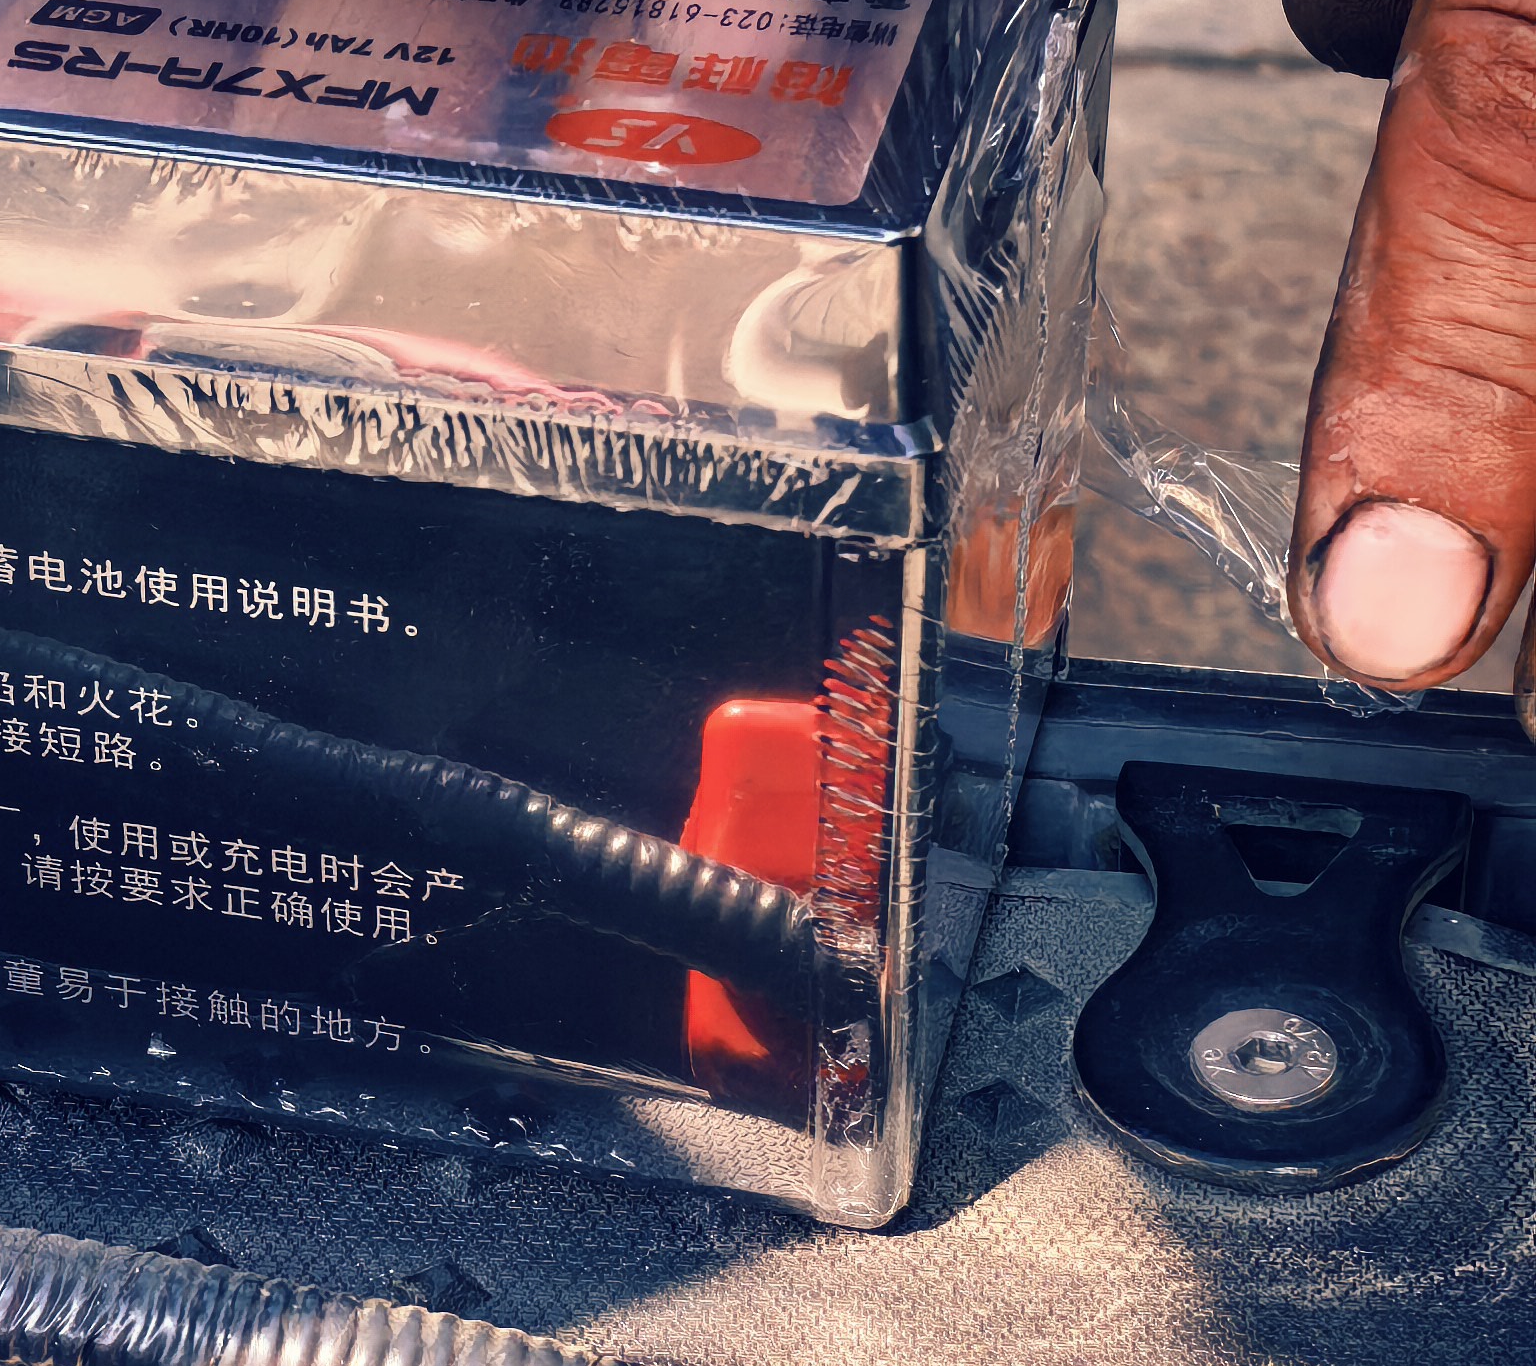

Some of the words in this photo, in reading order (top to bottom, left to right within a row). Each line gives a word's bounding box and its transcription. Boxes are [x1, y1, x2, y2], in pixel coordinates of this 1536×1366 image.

[44, 2, 145, 28] AGM
[382, 40, 462, 66] 12V
[4, 38, 443, 116] MFX7A-RS
[580, 114, 709, 156] YS
